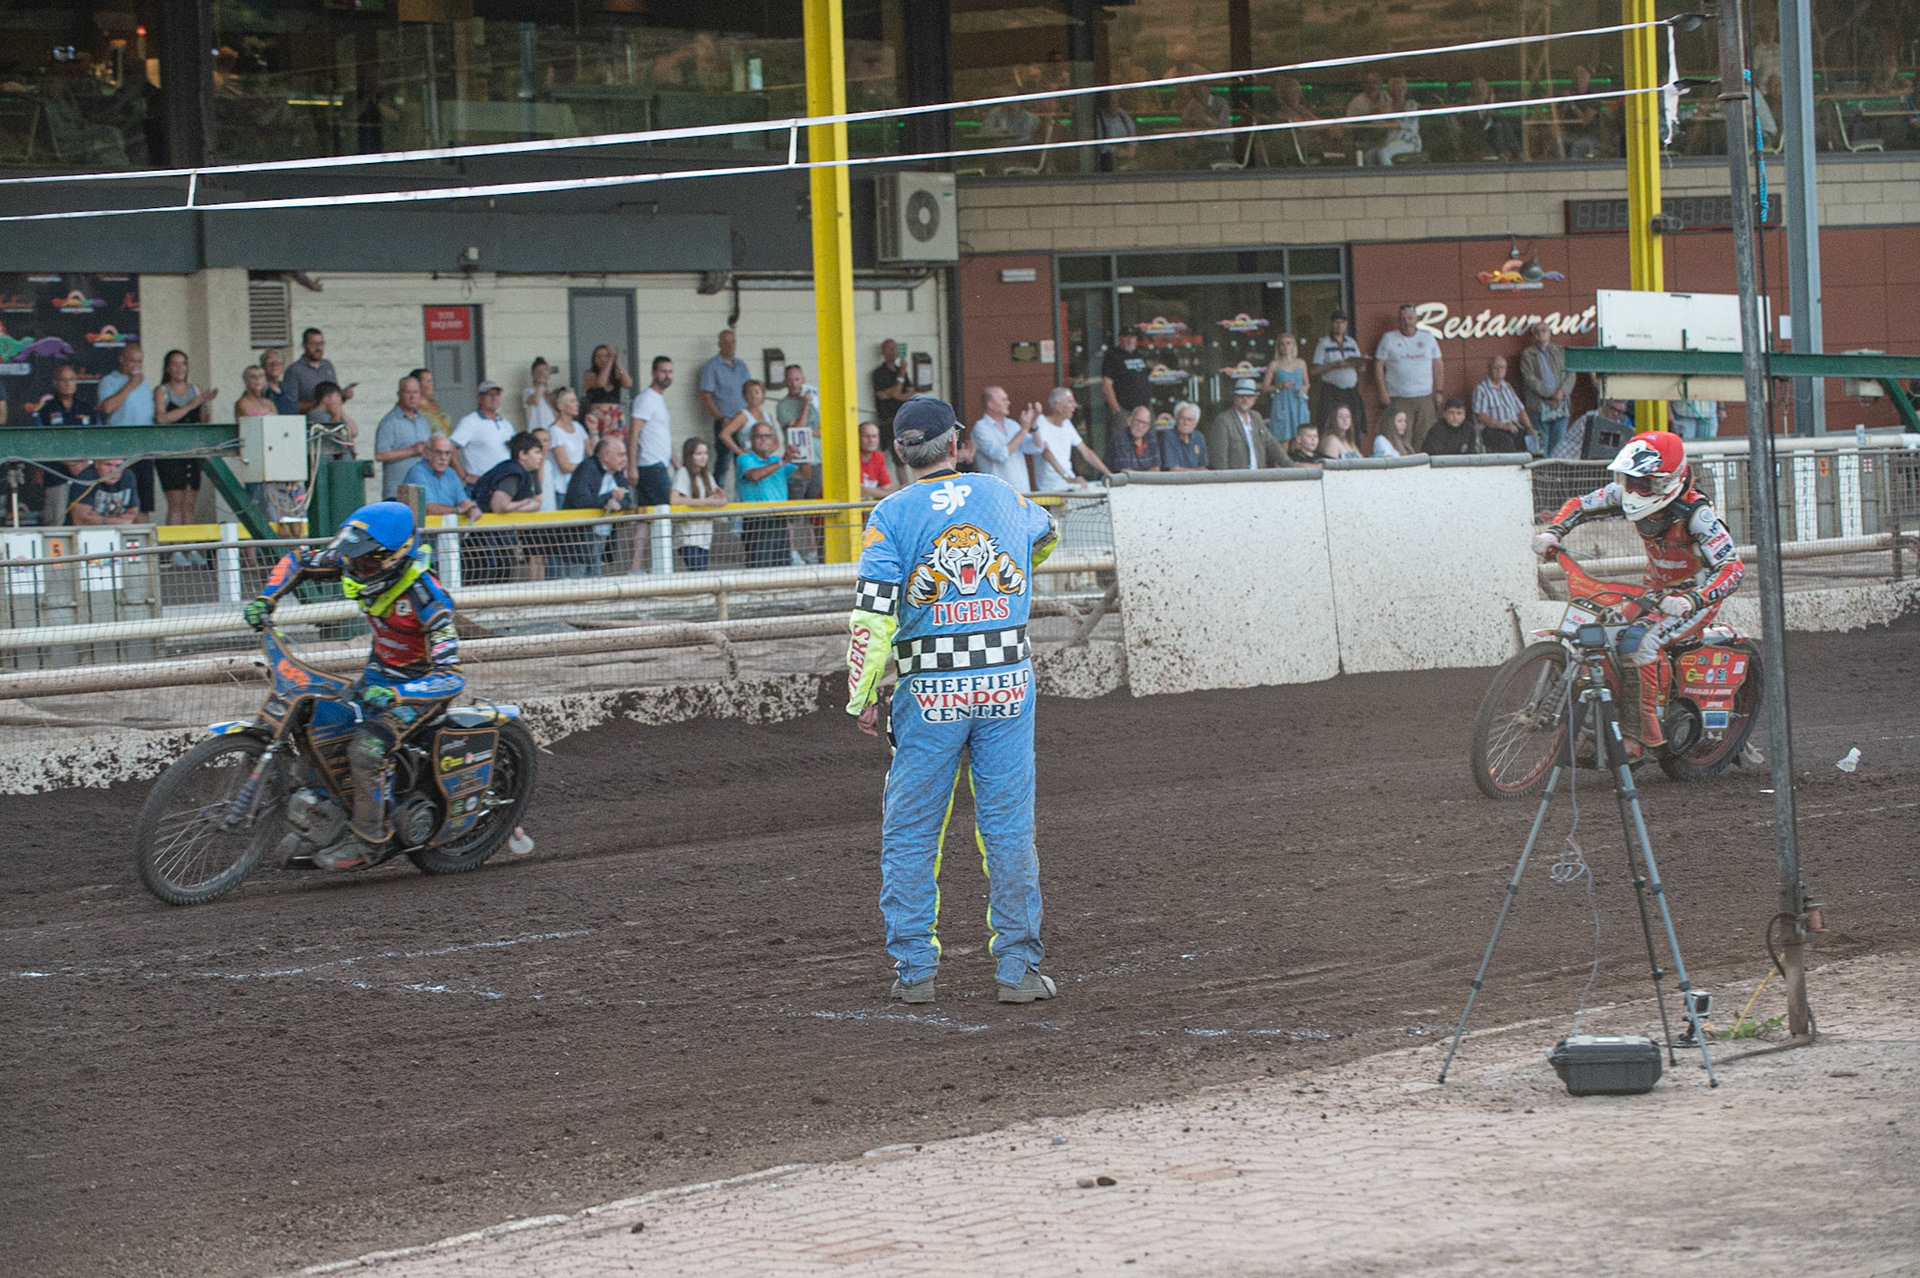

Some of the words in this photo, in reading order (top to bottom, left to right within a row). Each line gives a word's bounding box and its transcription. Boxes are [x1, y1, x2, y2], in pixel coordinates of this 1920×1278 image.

[1415, 302, 1597, 340] Restaurant
[931, 597, 1010, 625] TIGERS
[849, 624, 871, 702] IGERS
[911, 669, 1029, 694] SHEFFIELD
[916, 684, 1026, 708] WINDOW
[923, 702, 1020, 721] CENTRE
